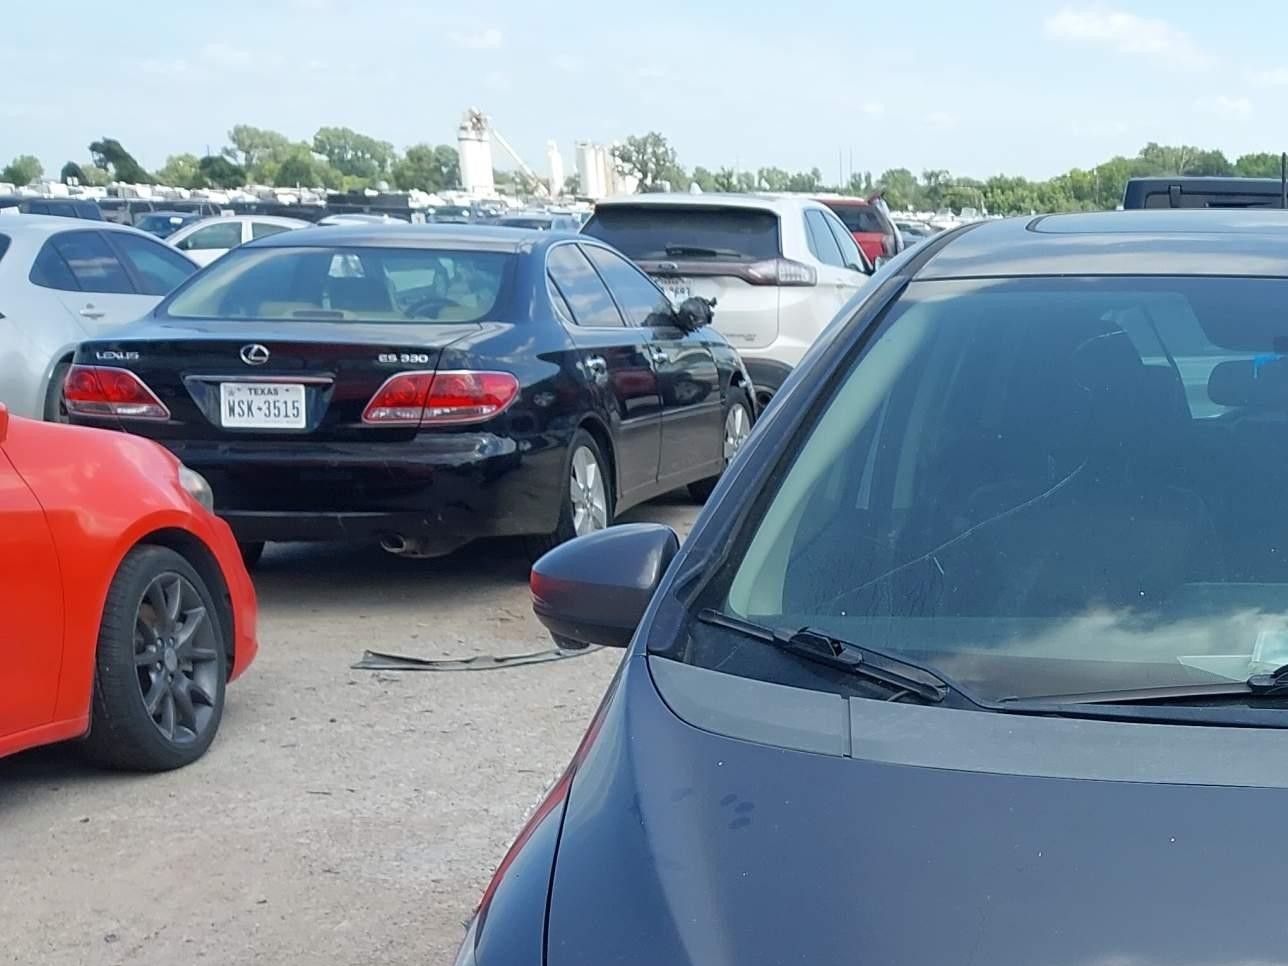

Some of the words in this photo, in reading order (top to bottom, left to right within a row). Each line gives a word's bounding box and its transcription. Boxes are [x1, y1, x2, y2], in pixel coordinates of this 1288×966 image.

[96, 351, 140, 361] LEXUS
[400, 353, 429, 364] 330
[247, 387, 279, 396] TEXAS
